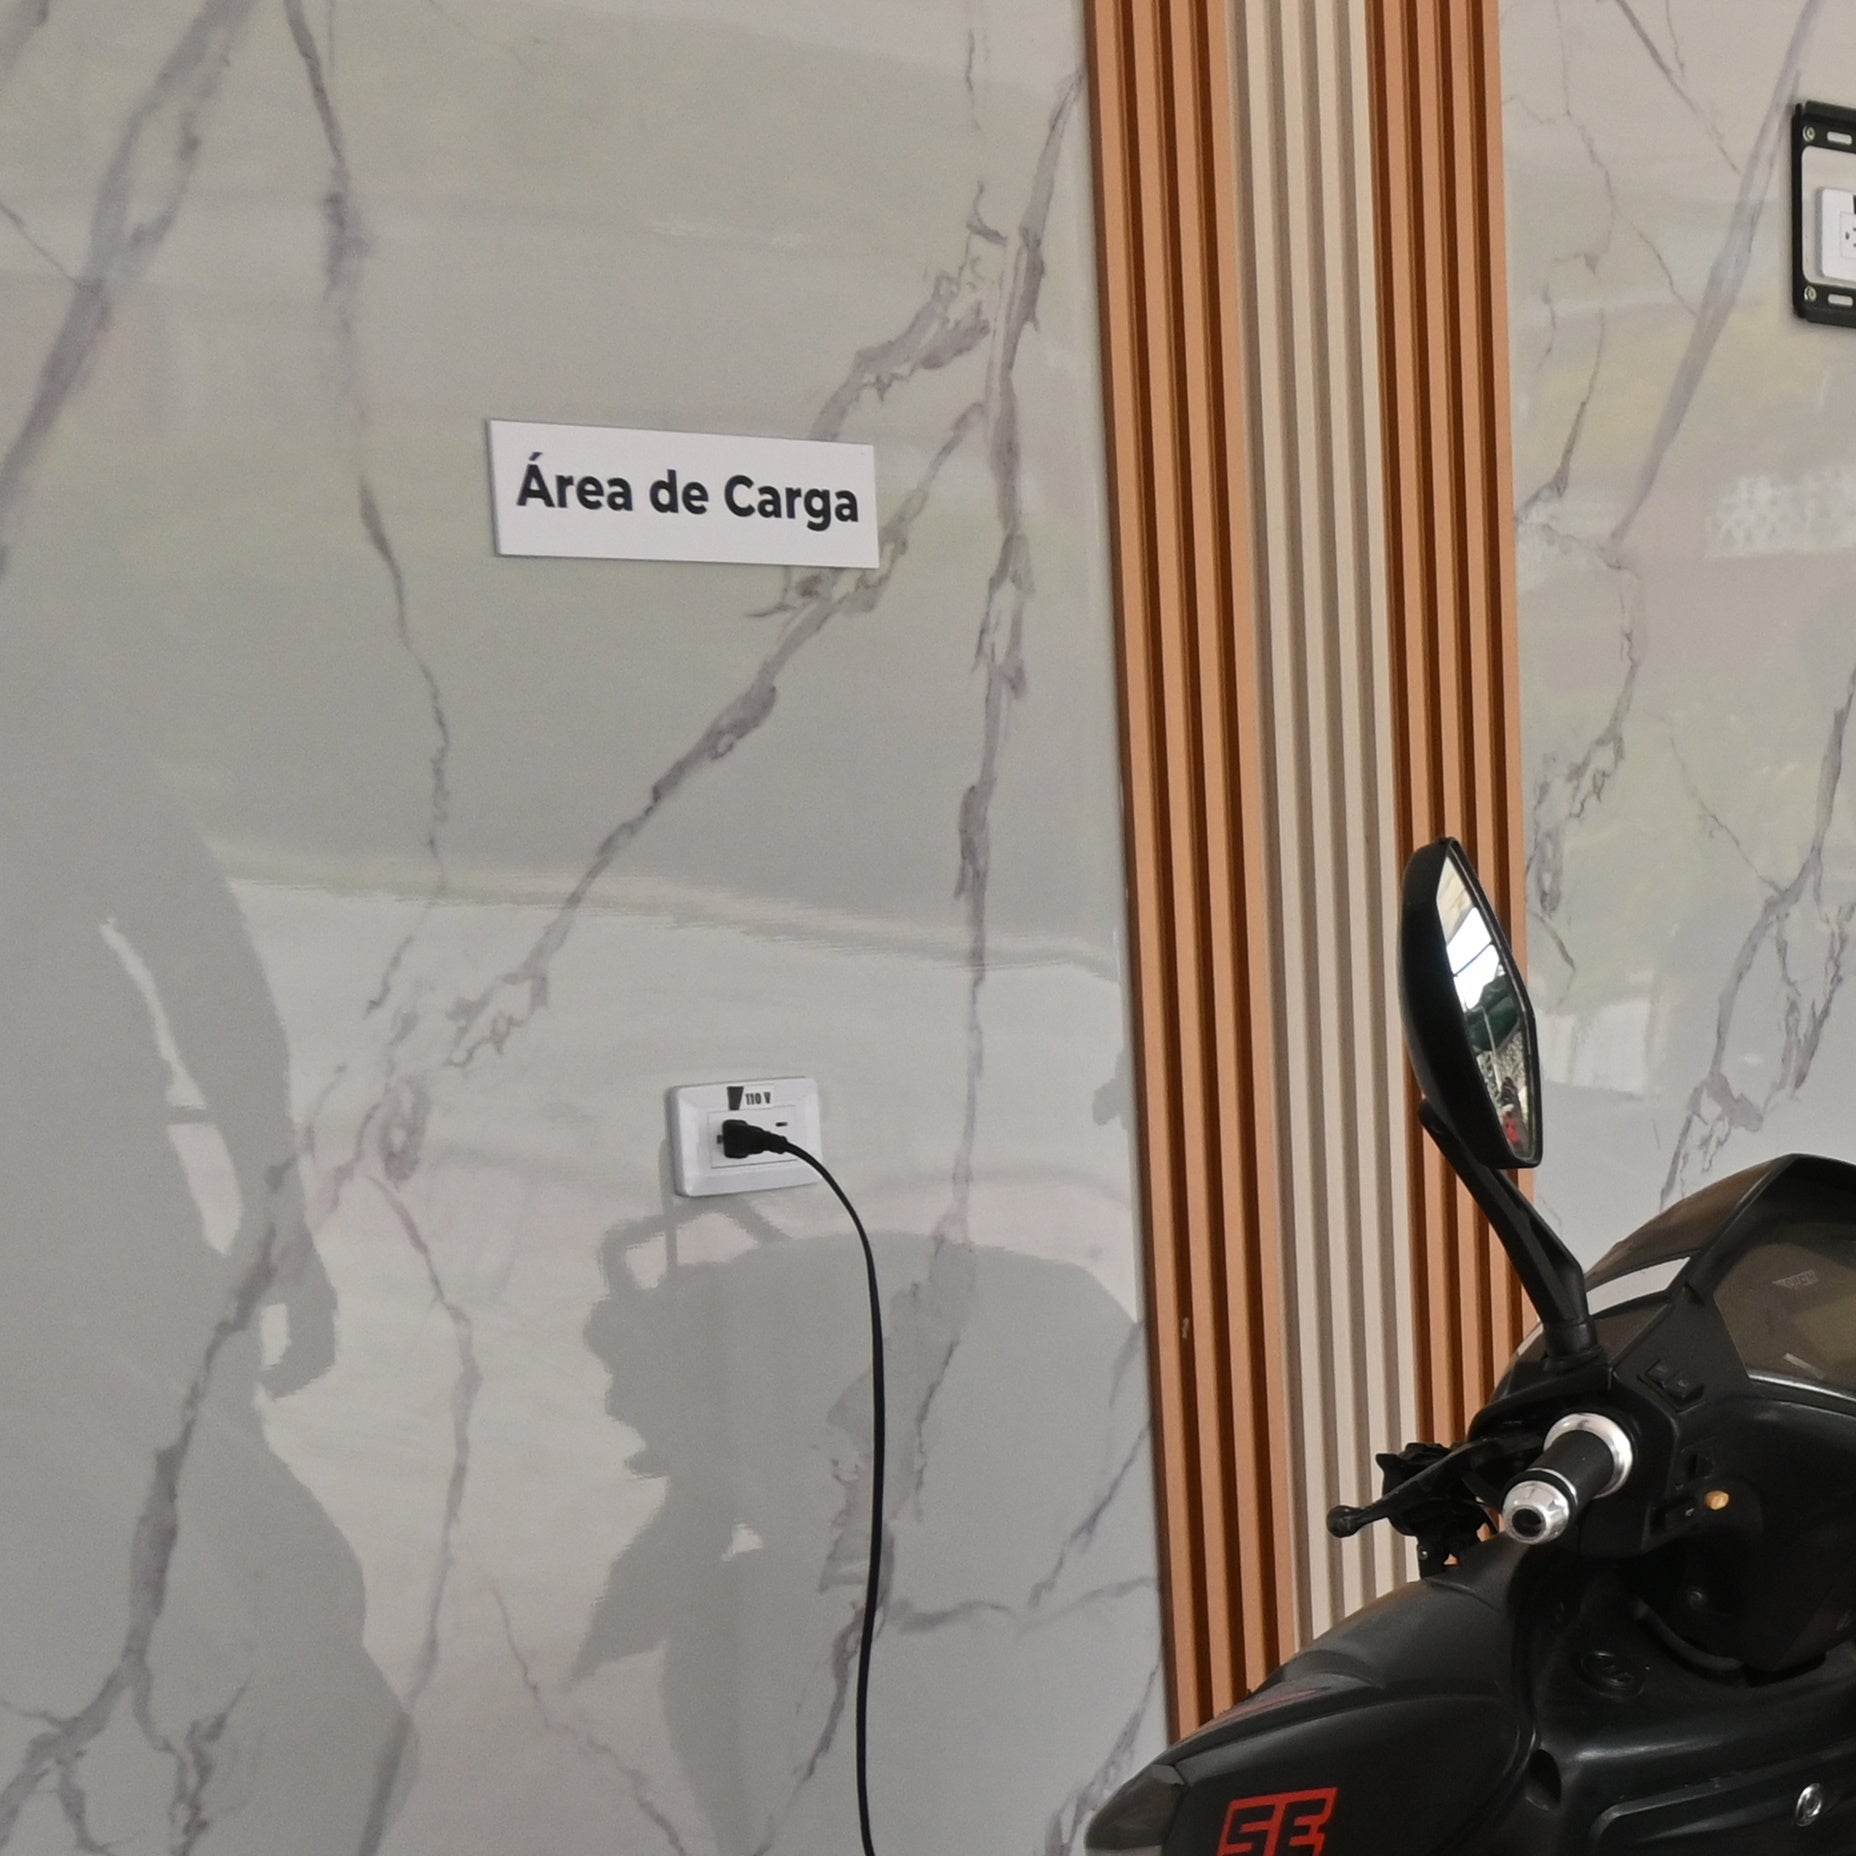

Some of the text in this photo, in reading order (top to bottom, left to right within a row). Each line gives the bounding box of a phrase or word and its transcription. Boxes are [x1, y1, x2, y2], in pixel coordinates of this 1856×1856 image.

[516, 451, 860, 531] Área de Carga
[745, 1091, 771, 1105] 110 V
